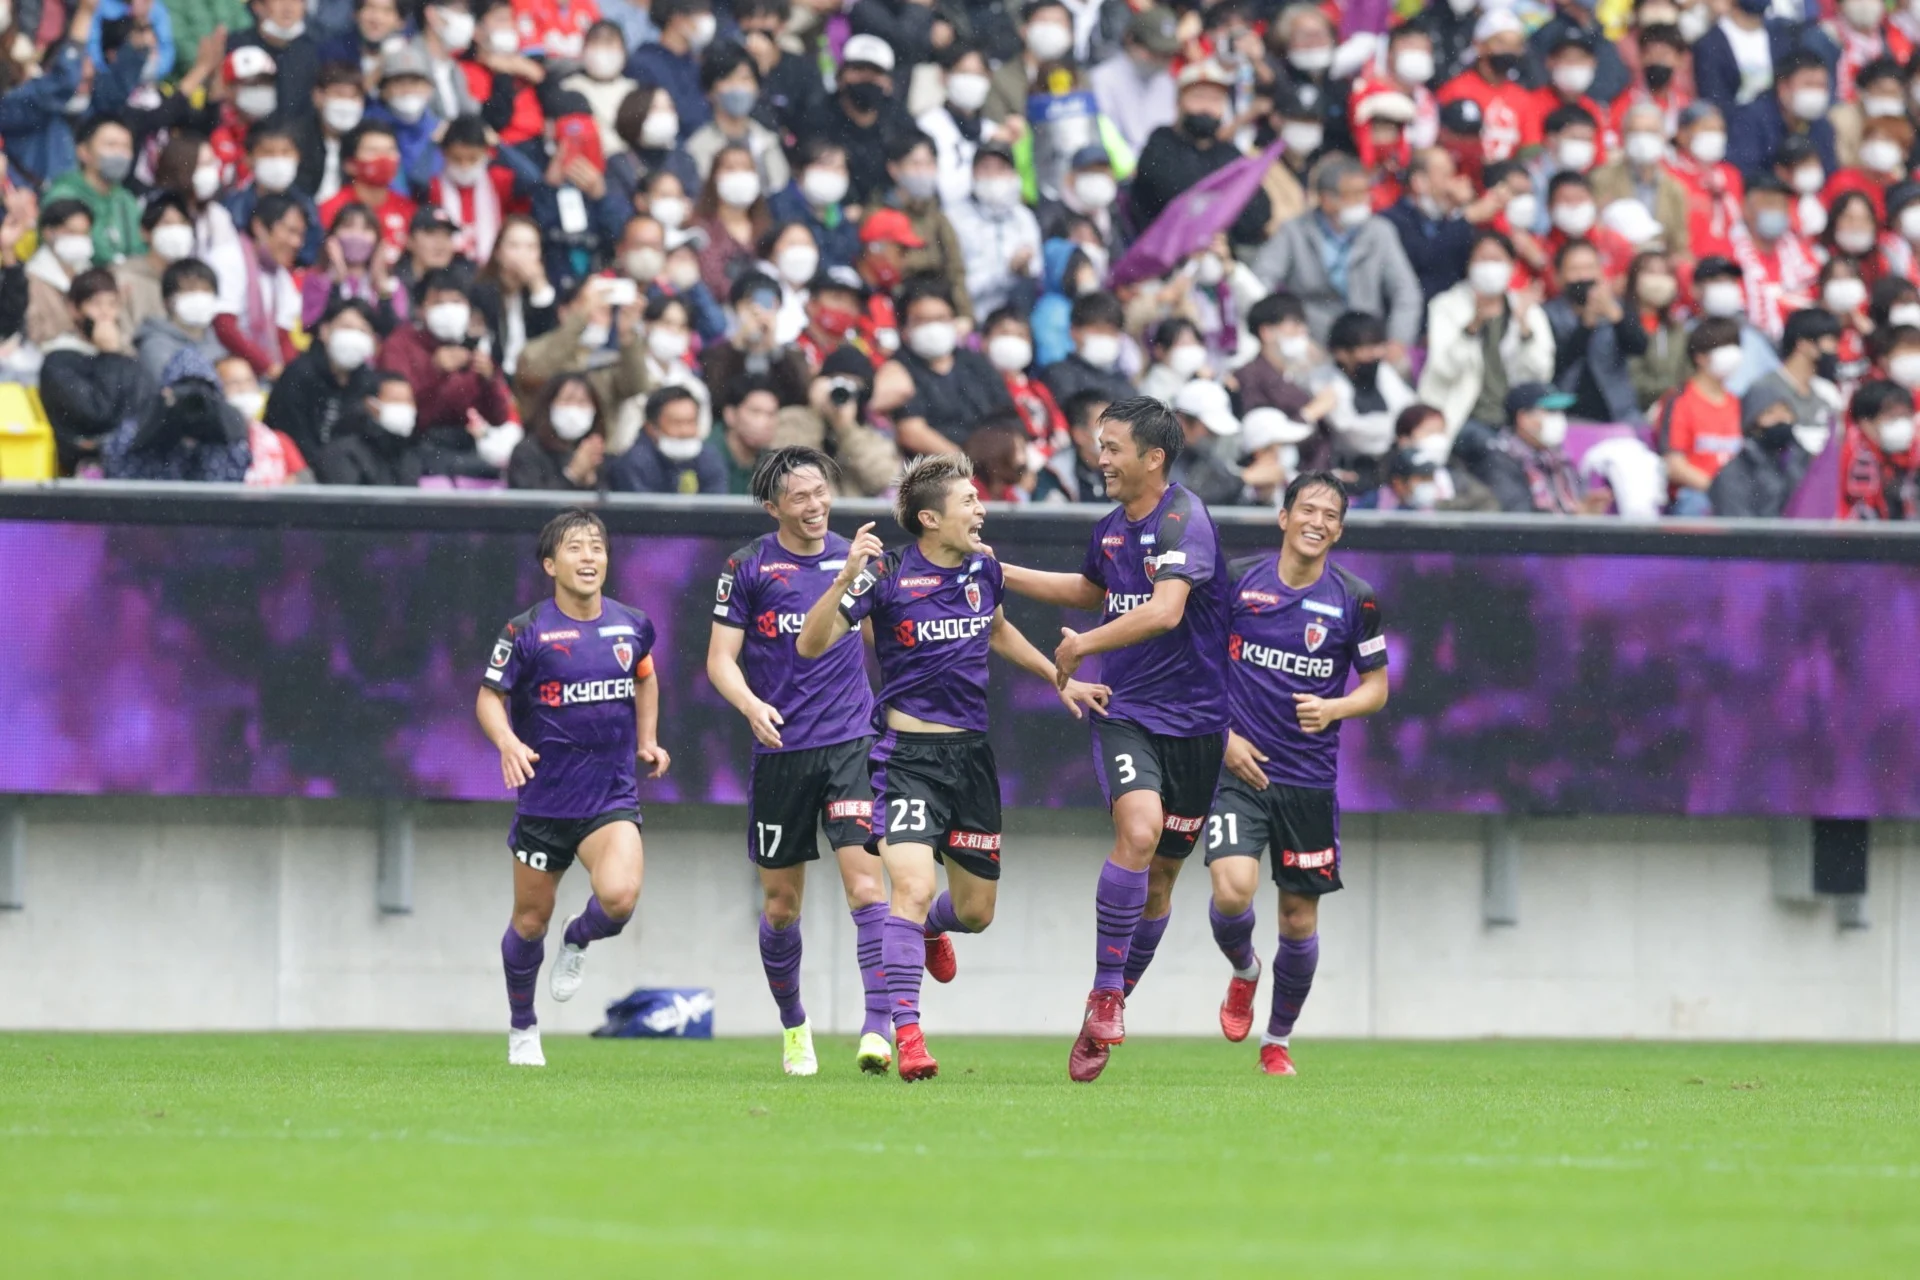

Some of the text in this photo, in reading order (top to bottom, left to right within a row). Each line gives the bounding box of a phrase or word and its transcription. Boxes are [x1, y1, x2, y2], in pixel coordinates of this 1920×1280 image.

[1242, 641, 1334, 678] KYOCERA
[563, 678, 636, 703] KYOCER
[1115, 754, 1136, 784] 3
[890, 799, 926, 832] 23
[1208, 812, 1238, 850] 31
[757, 821, 782, 858] 17
